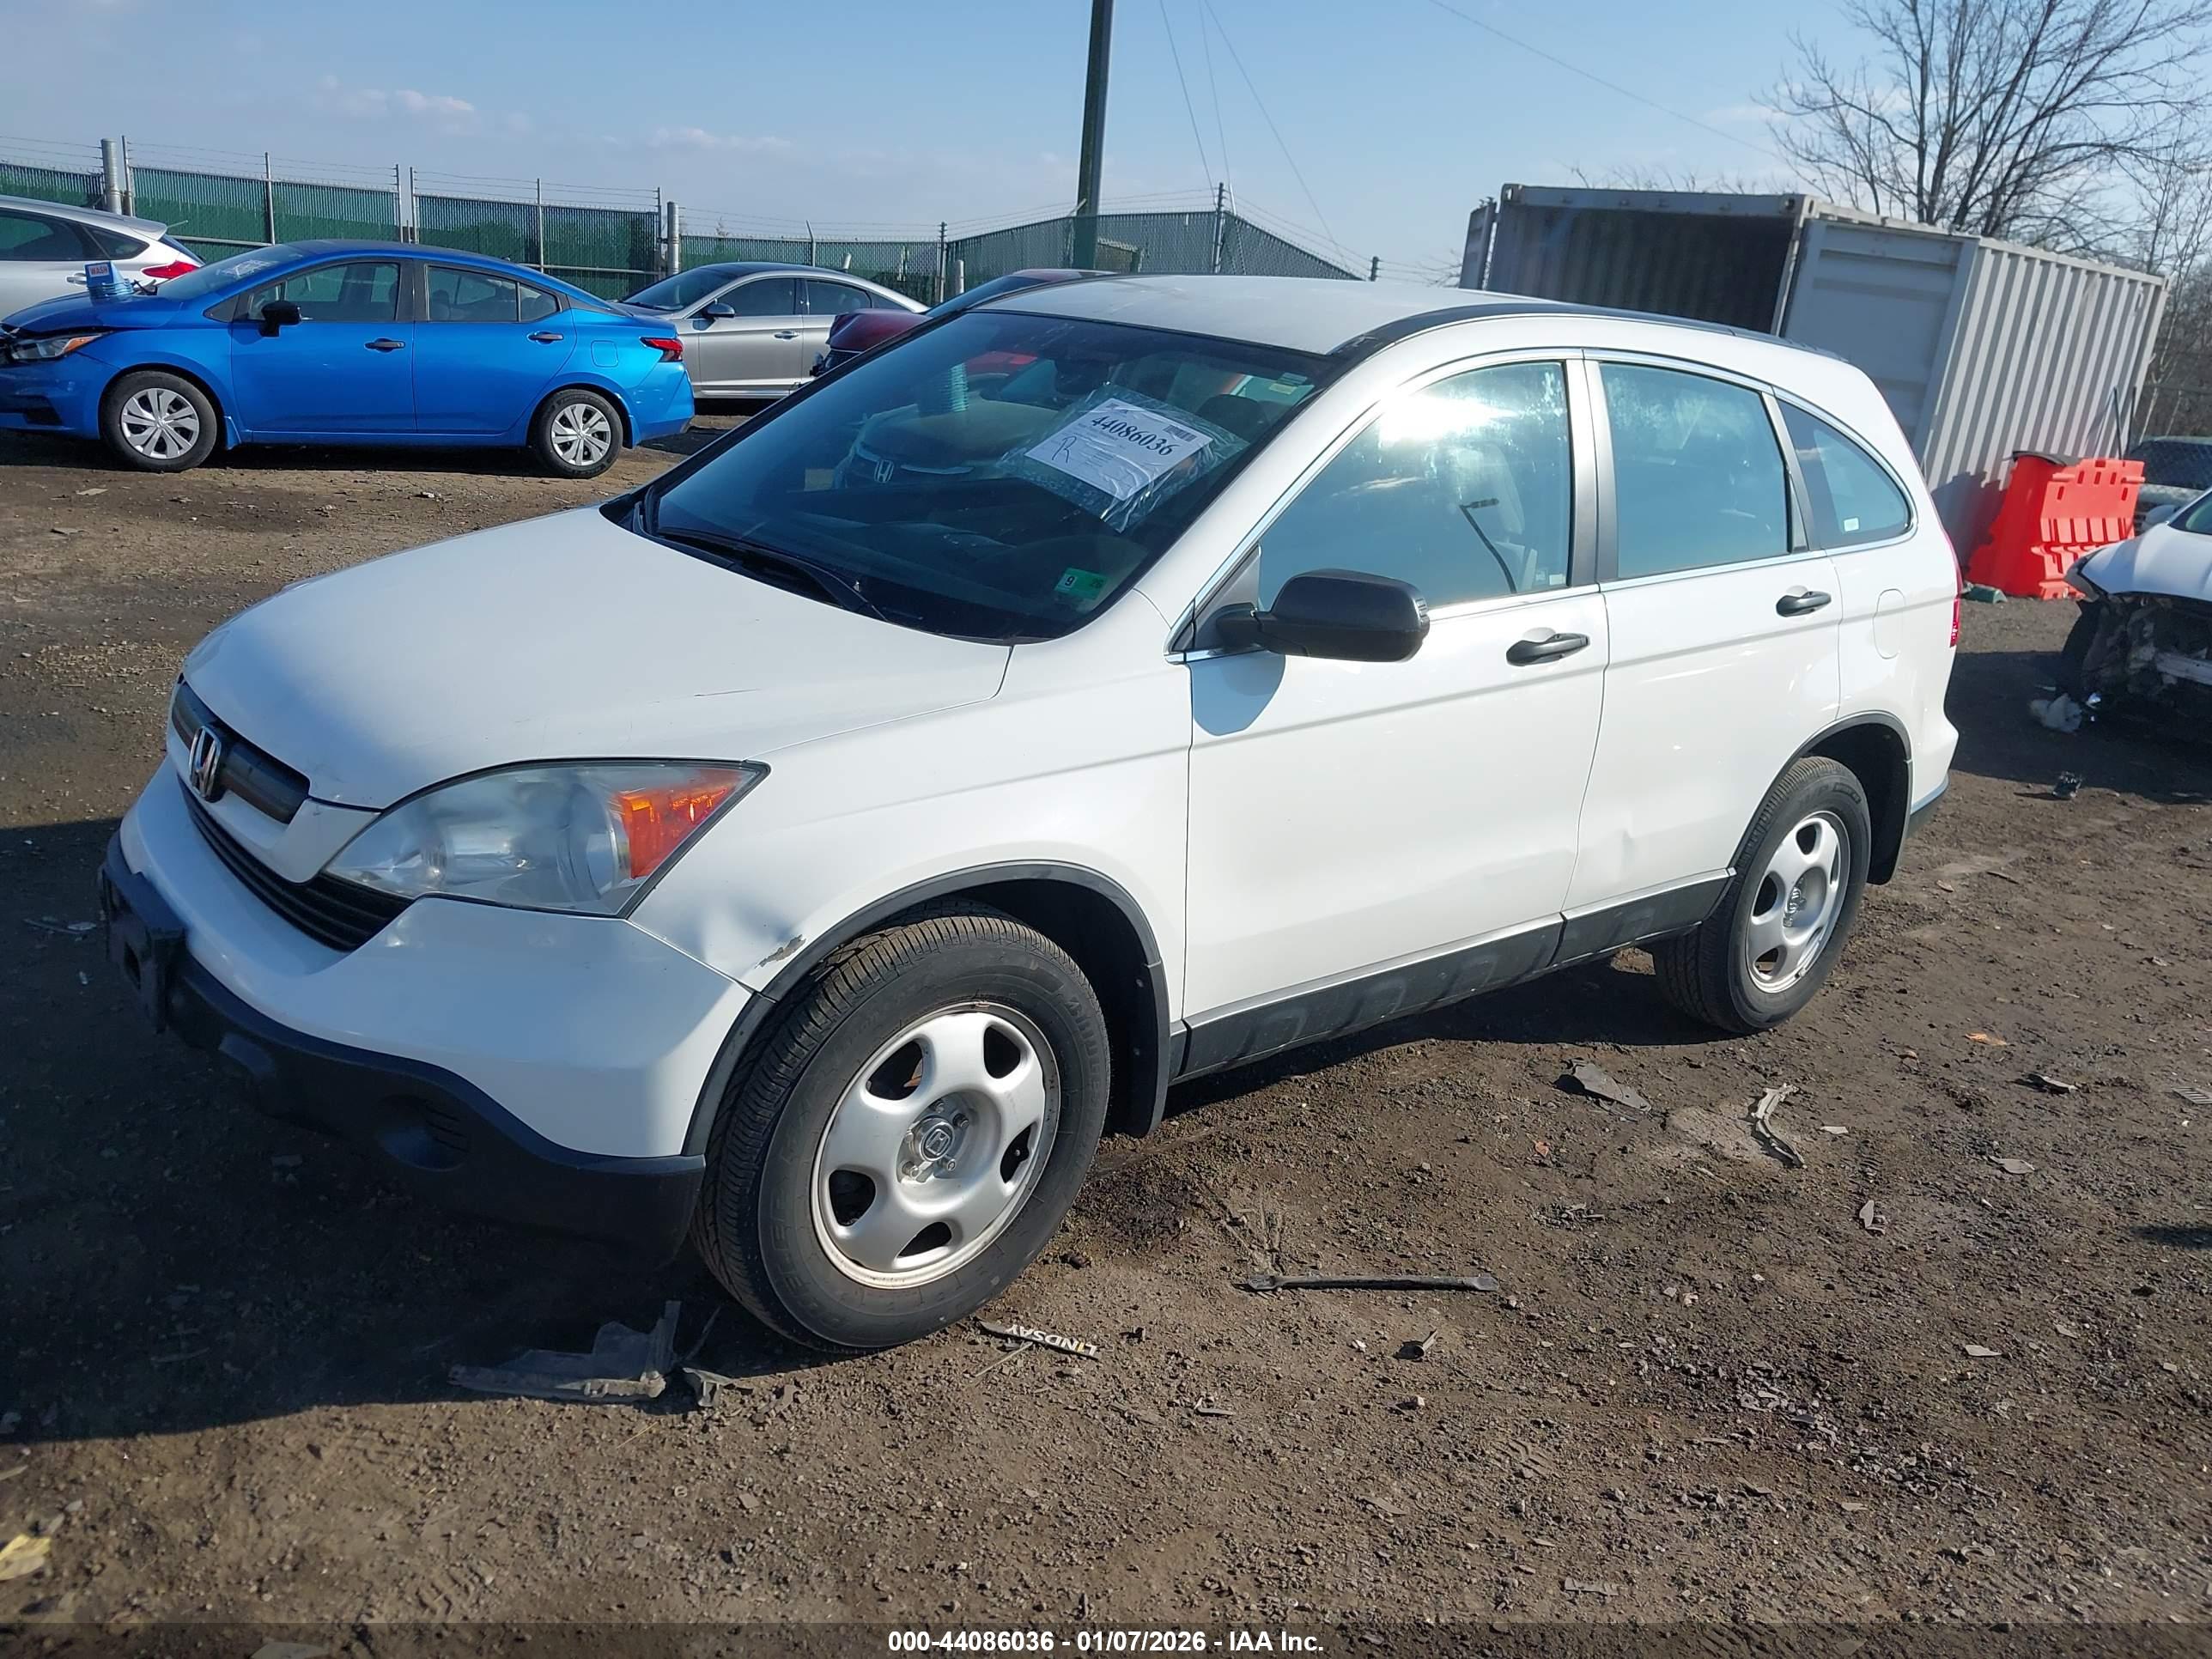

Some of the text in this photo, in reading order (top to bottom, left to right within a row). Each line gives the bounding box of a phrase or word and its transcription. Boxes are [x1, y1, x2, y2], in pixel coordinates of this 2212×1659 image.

[1051, 435, 1077, 463] R
[1091, 416, 1181, 456] 44086036
[1064, 575, 1075, 586] 9
